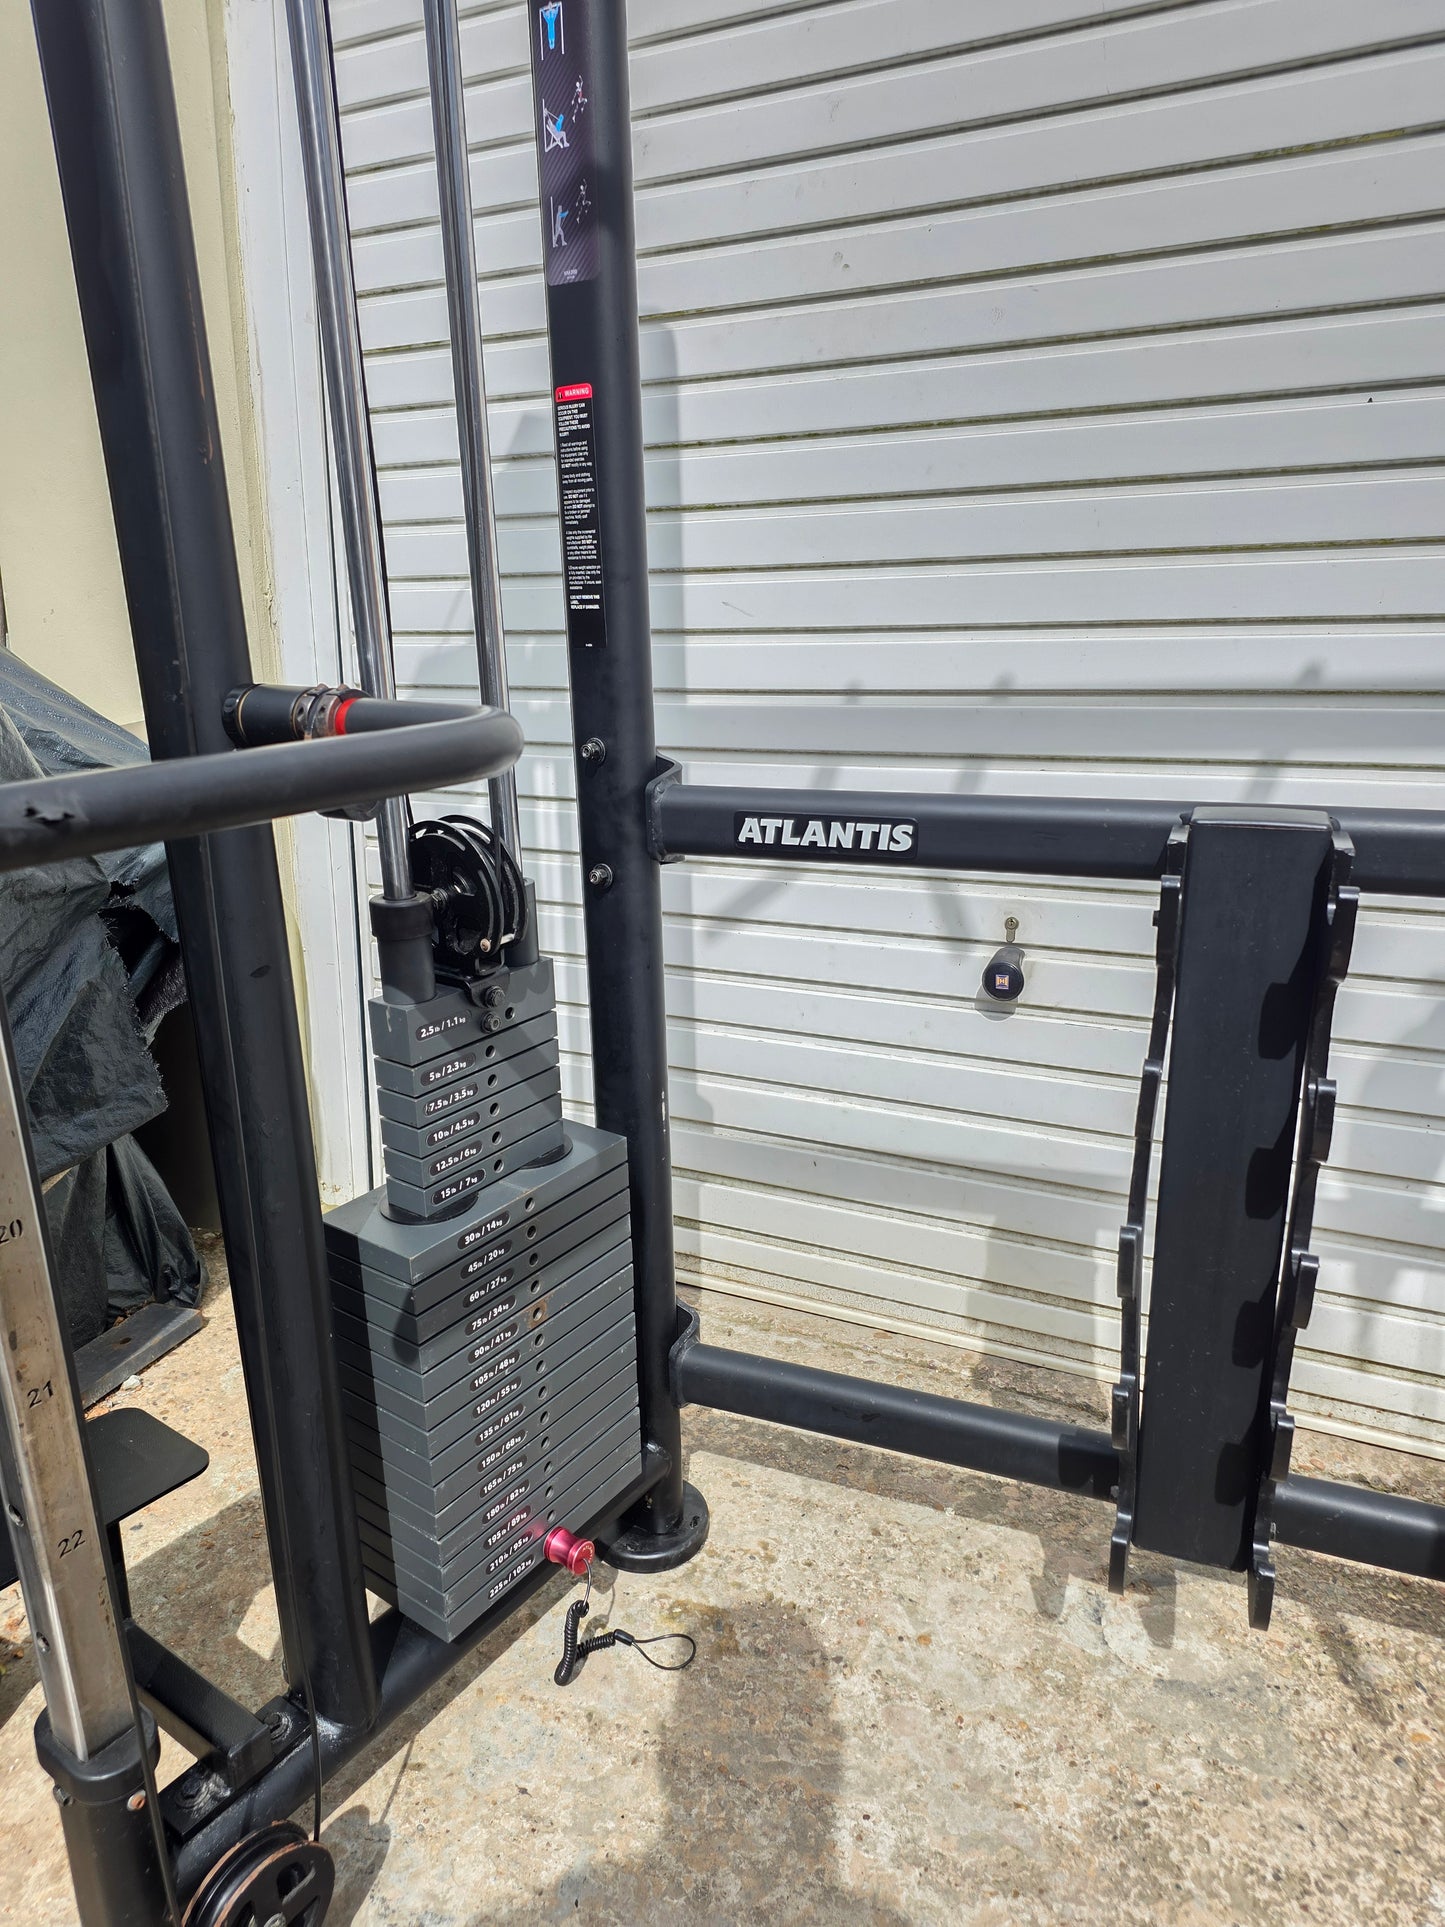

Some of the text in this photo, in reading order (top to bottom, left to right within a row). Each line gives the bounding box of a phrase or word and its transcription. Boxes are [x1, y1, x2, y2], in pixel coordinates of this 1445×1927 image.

[564, 387, 589, 397] WARNING
[737, 817, 913, 852] ATLANTIS
[27, 1380, 54, 1409] 21
[58, 1529, 86, 1559] 22
